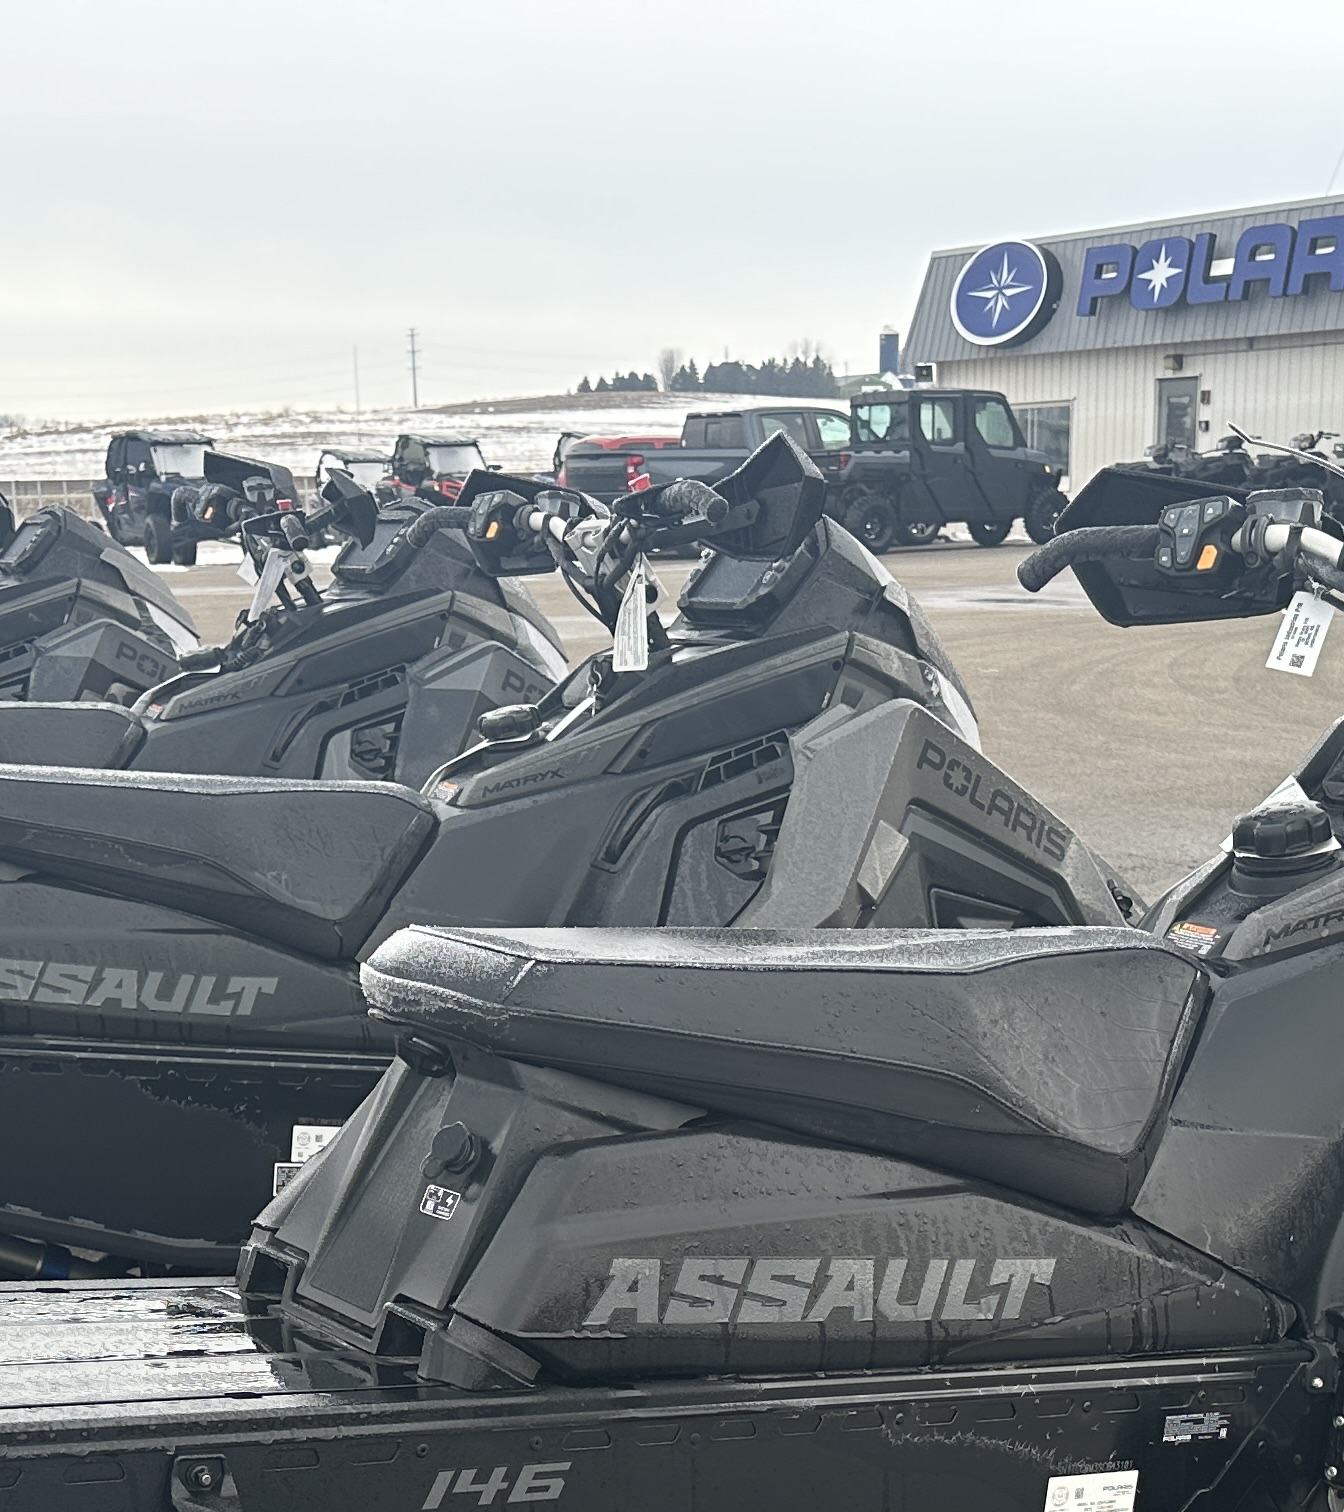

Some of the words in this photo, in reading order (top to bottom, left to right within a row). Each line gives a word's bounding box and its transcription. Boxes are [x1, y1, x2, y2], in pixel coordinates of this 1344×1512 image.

[482, 766, 565, 798] MATRYX
[916, 738, 1069, 862] POLARIS
[582, 1257, 1058, 1327] ASSAULT
[421, 1461, 575, 1511] 146
